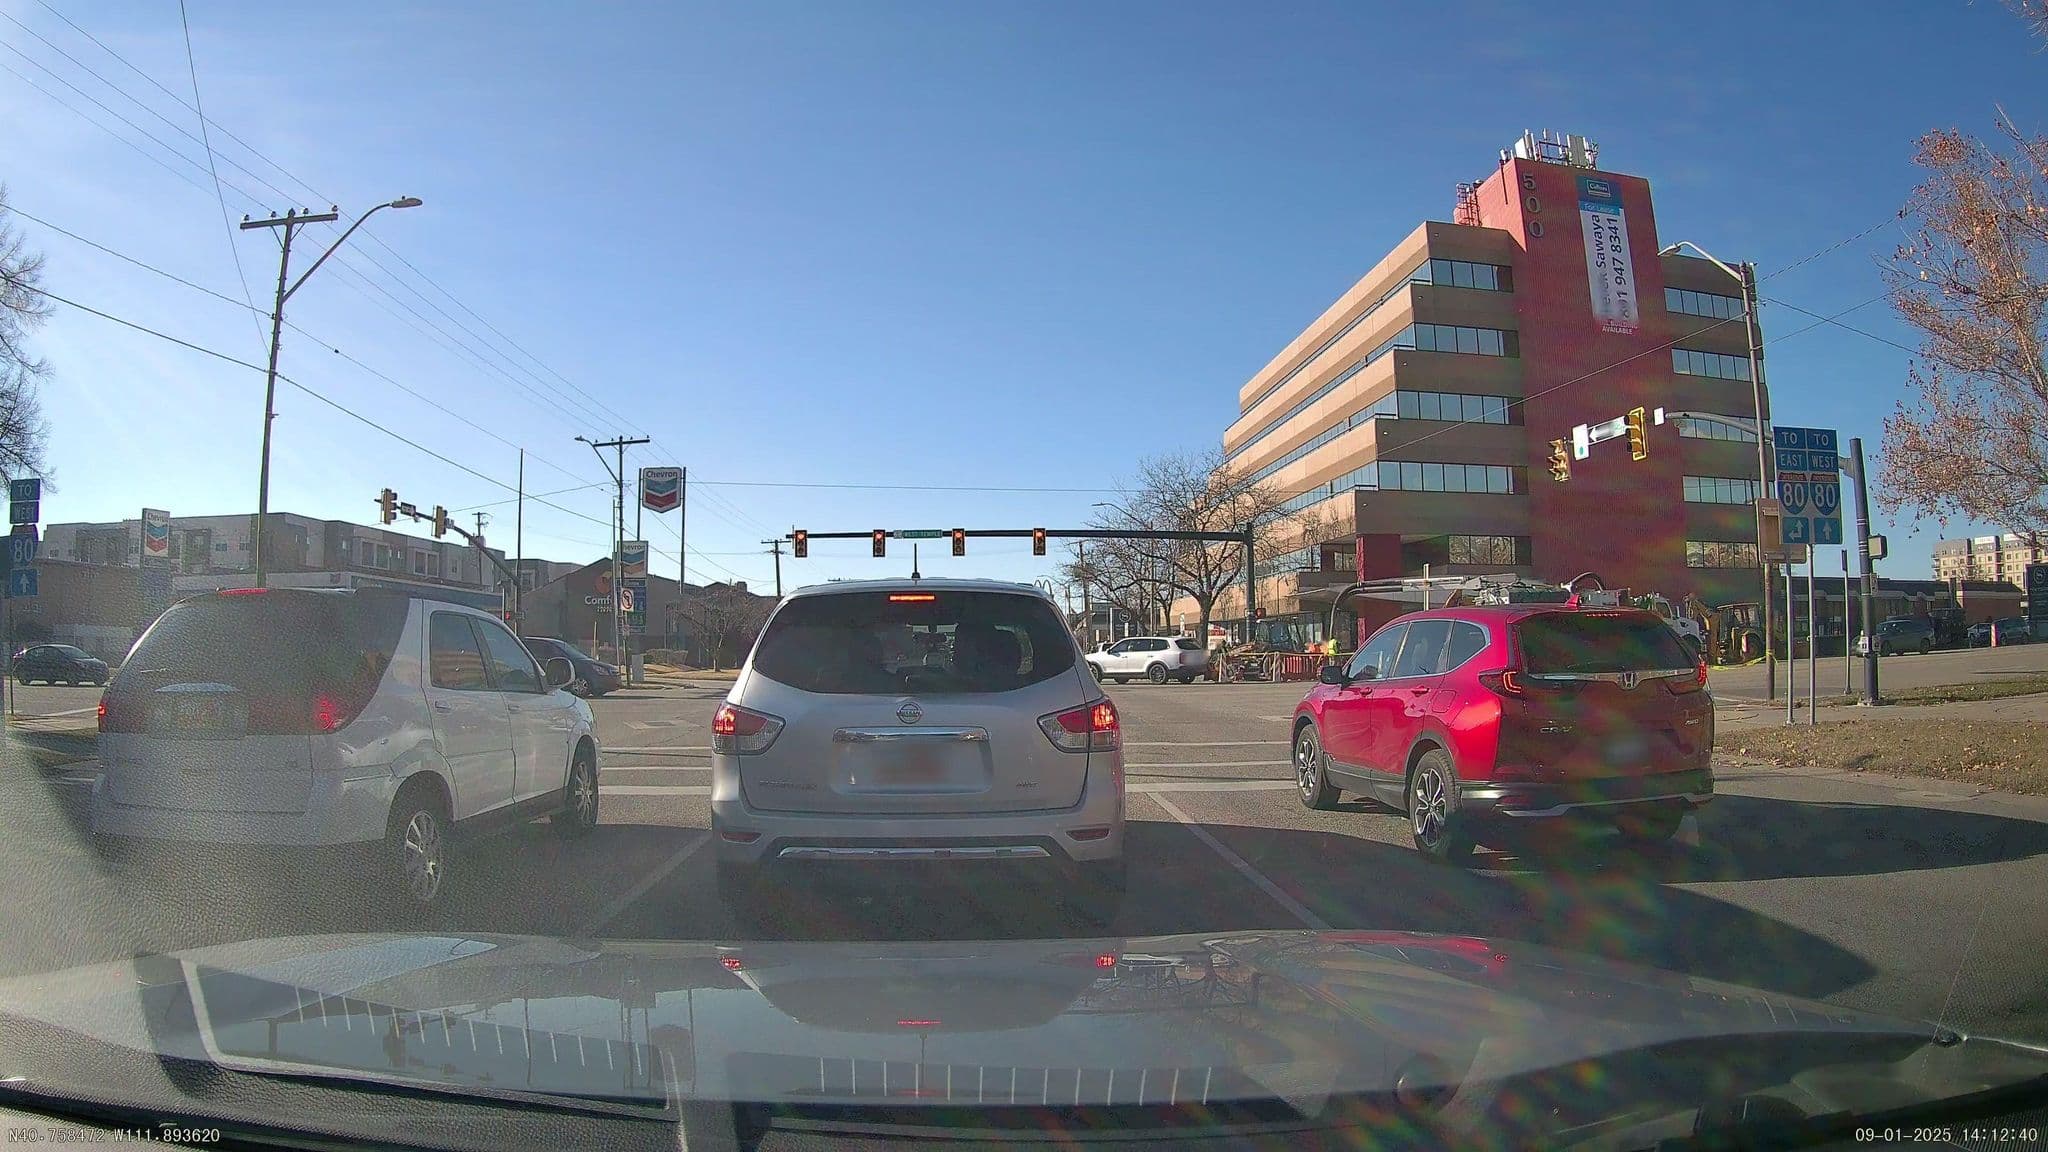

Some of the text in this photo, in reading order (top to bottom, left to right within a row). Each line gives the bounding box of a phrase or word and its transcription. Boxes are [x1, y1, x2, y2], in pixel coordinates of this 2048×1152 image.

[1522, 172, 1545, 239] 500
[1591, 214, 1607, 268] Sawaya
[1606, 217, 1622, 253] 8341
[1612, 258, 1627, 286] 947
[1781, 431, 1798, 445] TO
[1813, 433, 1829, 446] TO
[1780, 454, 1803, 467] EAST
[1811, 455, 1835, 468] WEST
[645, 470, 678, 479] Chevron
[17, 484, 32, 497] TO
[1782, 482, 1805, 507] 80
[1814, 483, 1836, 508] 80
[14, 507, 35, 520] WEST
[14, 538, 34, 563] 80
